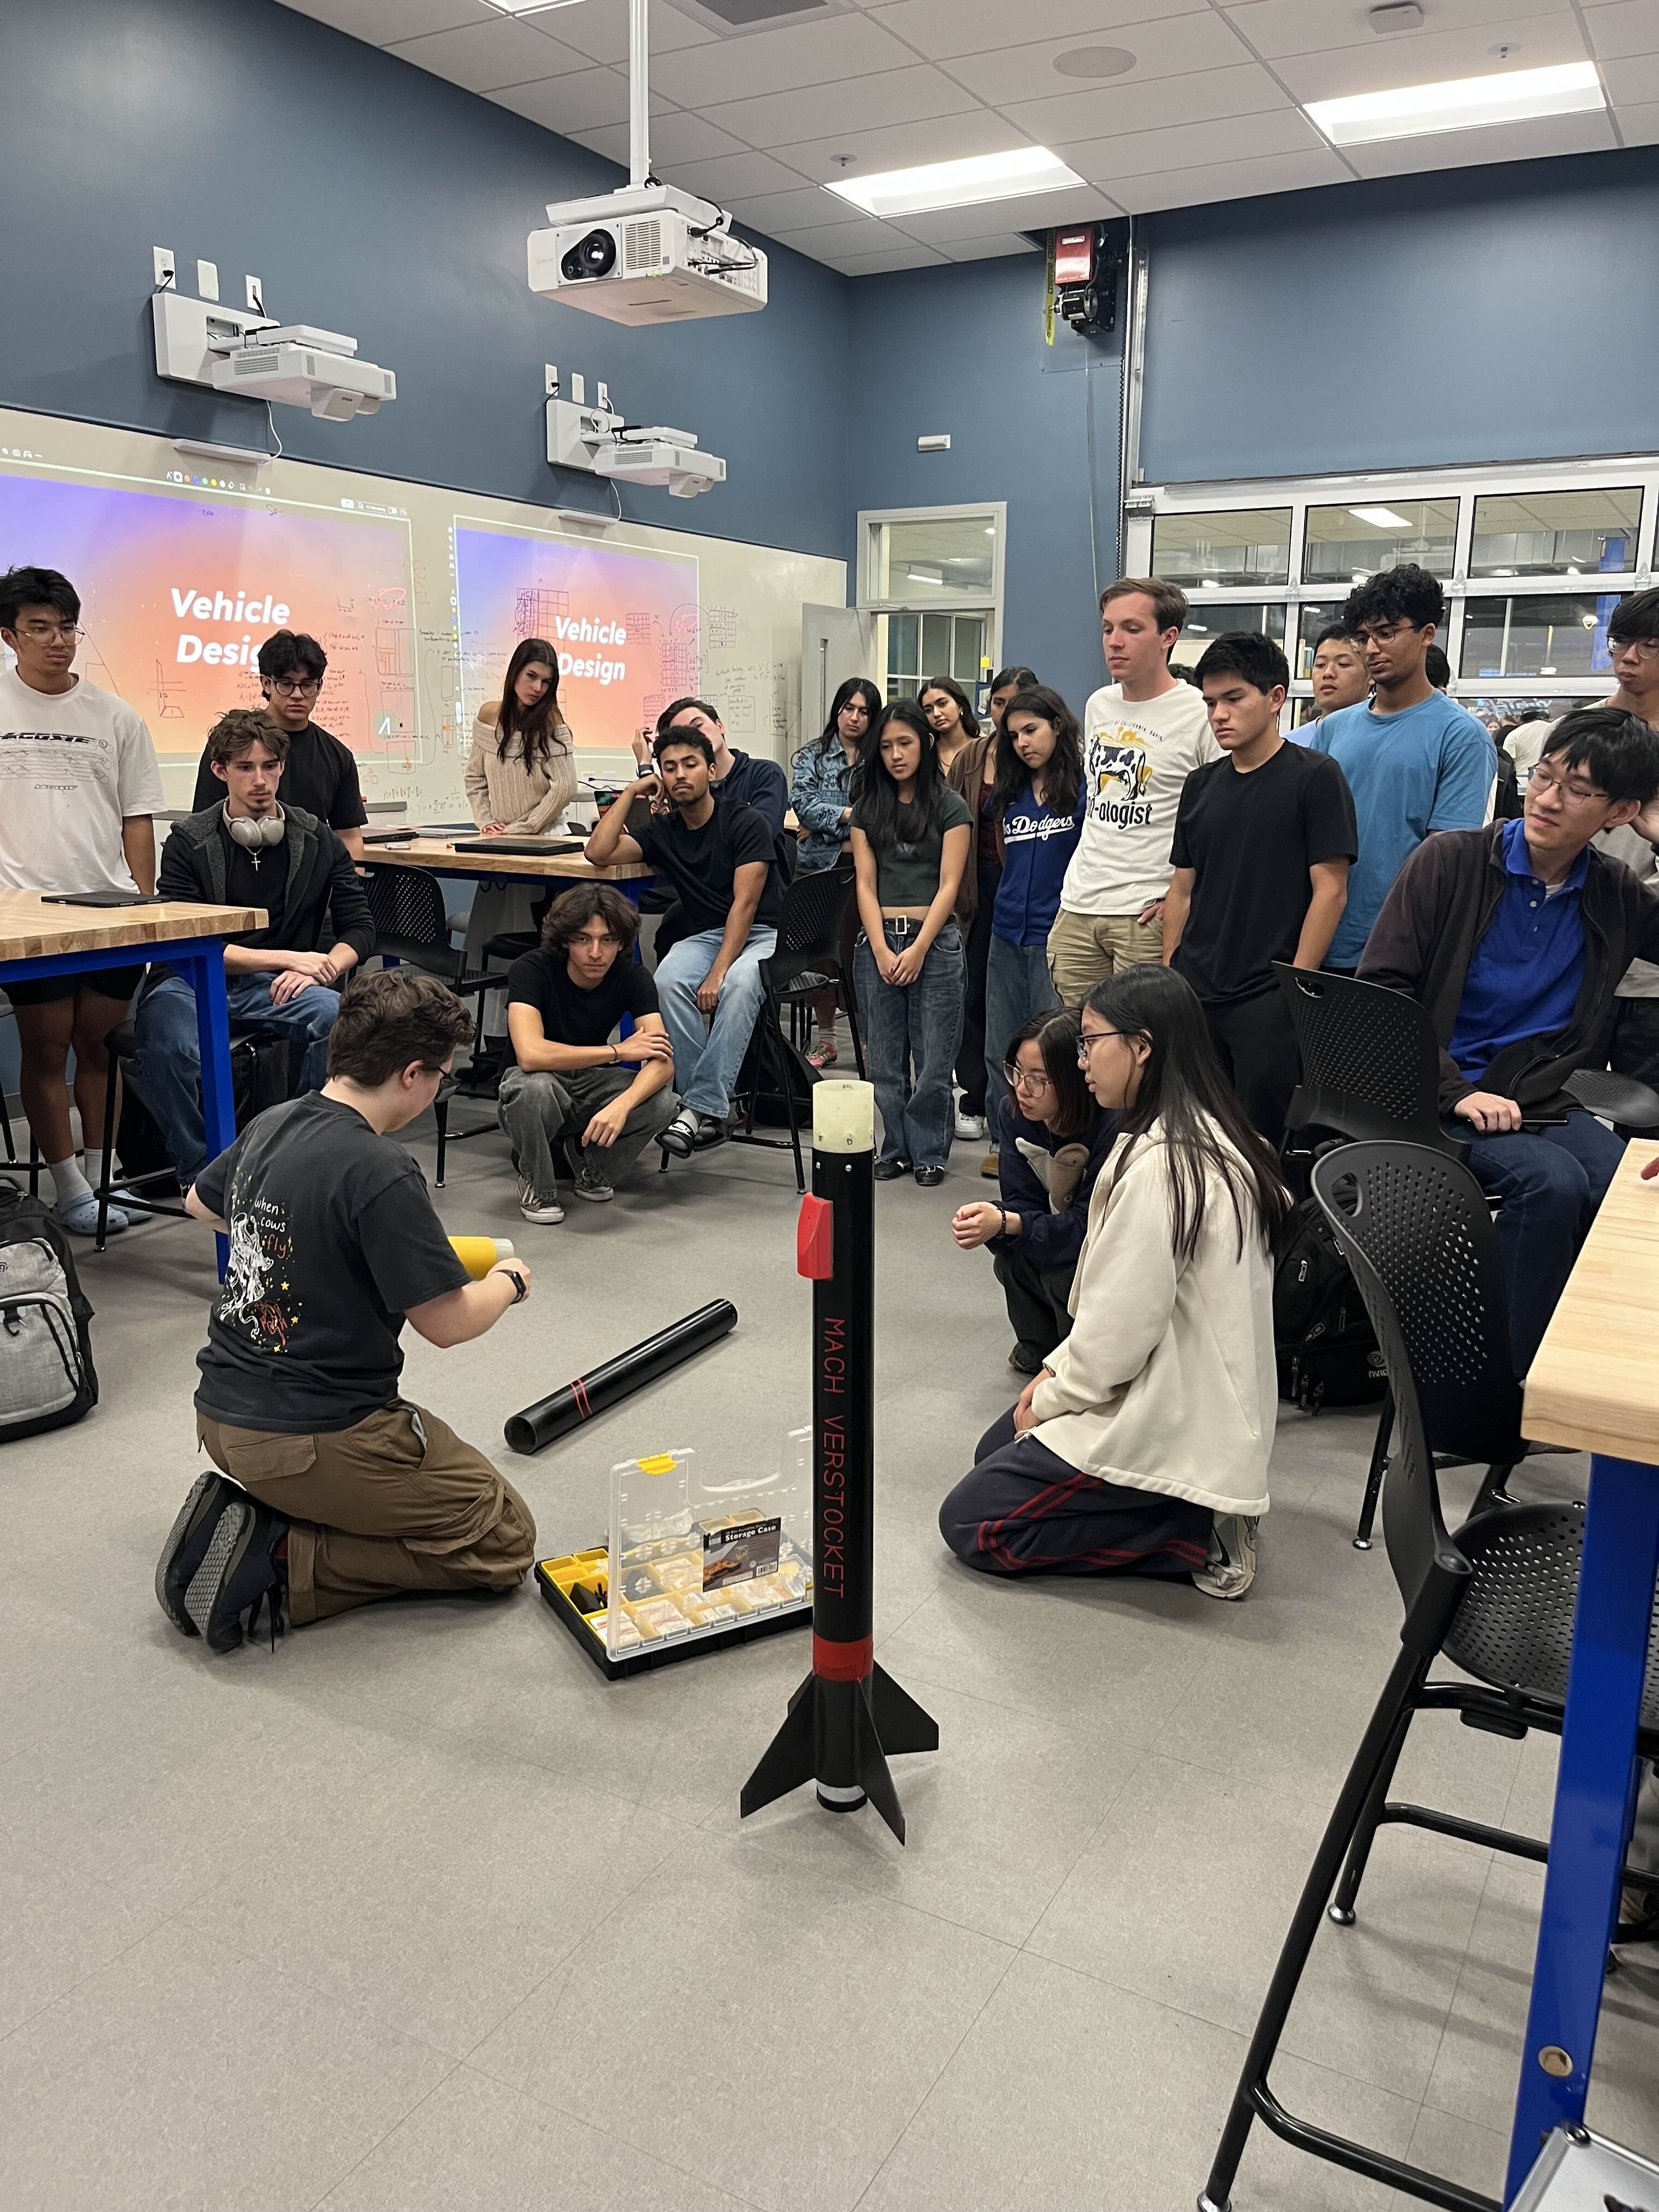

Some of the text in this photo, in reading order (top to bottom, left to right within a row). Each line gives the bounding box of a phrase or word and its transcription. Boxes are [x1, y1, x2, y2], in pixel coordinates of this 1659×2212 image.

[171, 588, 290, 625] Vehicle
[555, 616, 627, 645] Vehicle
[177, 635, 263, 673] Desig
[558, 652, 625, 685] Design
[0, 732, 96, 744] ACOSTE
[1012, 814, 1075, 841] Dodgers
[255, 1197, 279, 1216] when
[261, 1217, 286, 1232] cows
[266, 1234, 287, 1259] fly
[823, 1318, 845, 1598] MACH VERSTOCKET
[725, 1525, 776, 1542] Storage Case
